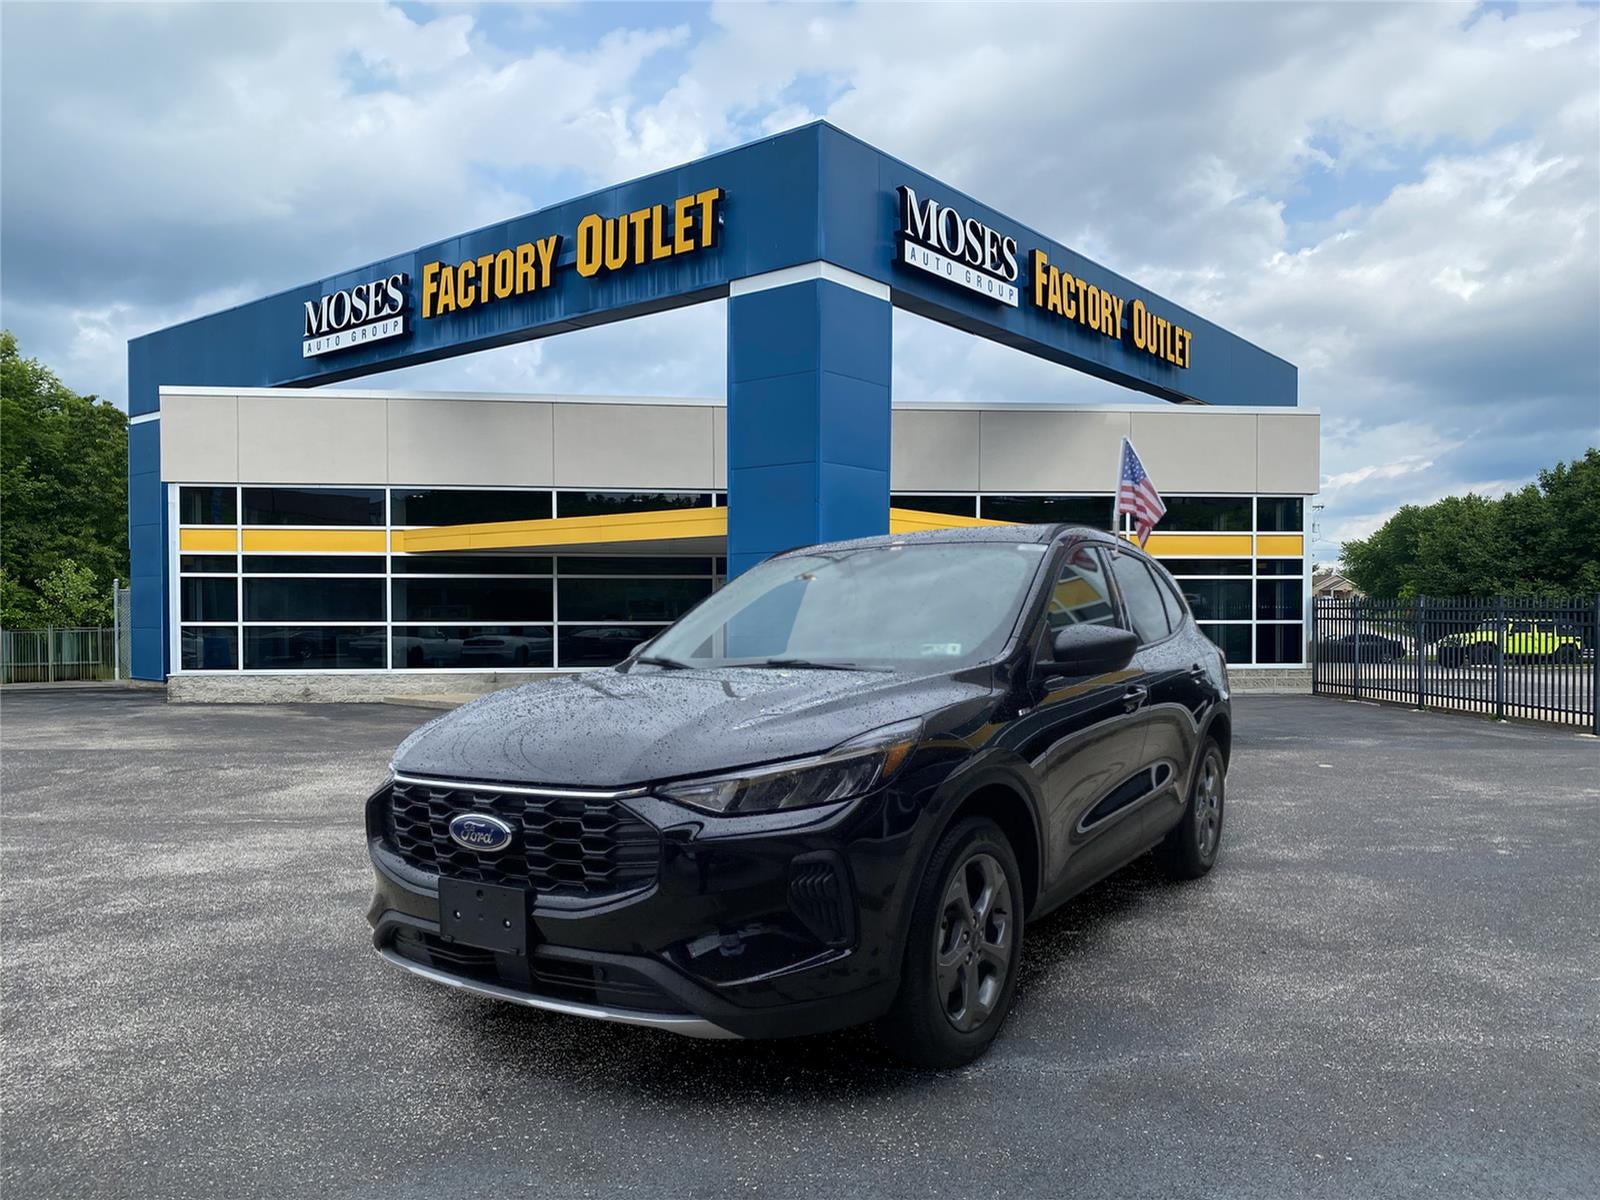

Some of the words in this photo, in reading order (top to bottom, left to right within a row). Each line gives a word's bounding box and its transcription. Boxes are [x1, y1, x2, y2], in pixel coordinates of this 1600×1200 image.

[422, 235, 559, 318] FACTORY
[576, 188, 720, 277] OUTLET
[904, 185, 1019, 281] MOSES
[910, 247, 952, 275] AUTO
[965, 270, 1014, 301] GROUP
[304, 275, 404, 336] MOSES
[1035, 249, 1124, 339] FACTORY
[1133, 300, 1192, 368] OUTLET
[307, 335, 342, 353] AUTO
[351, 320, 400, 341] GROUP
[460, 821, 494, 844] Ford
